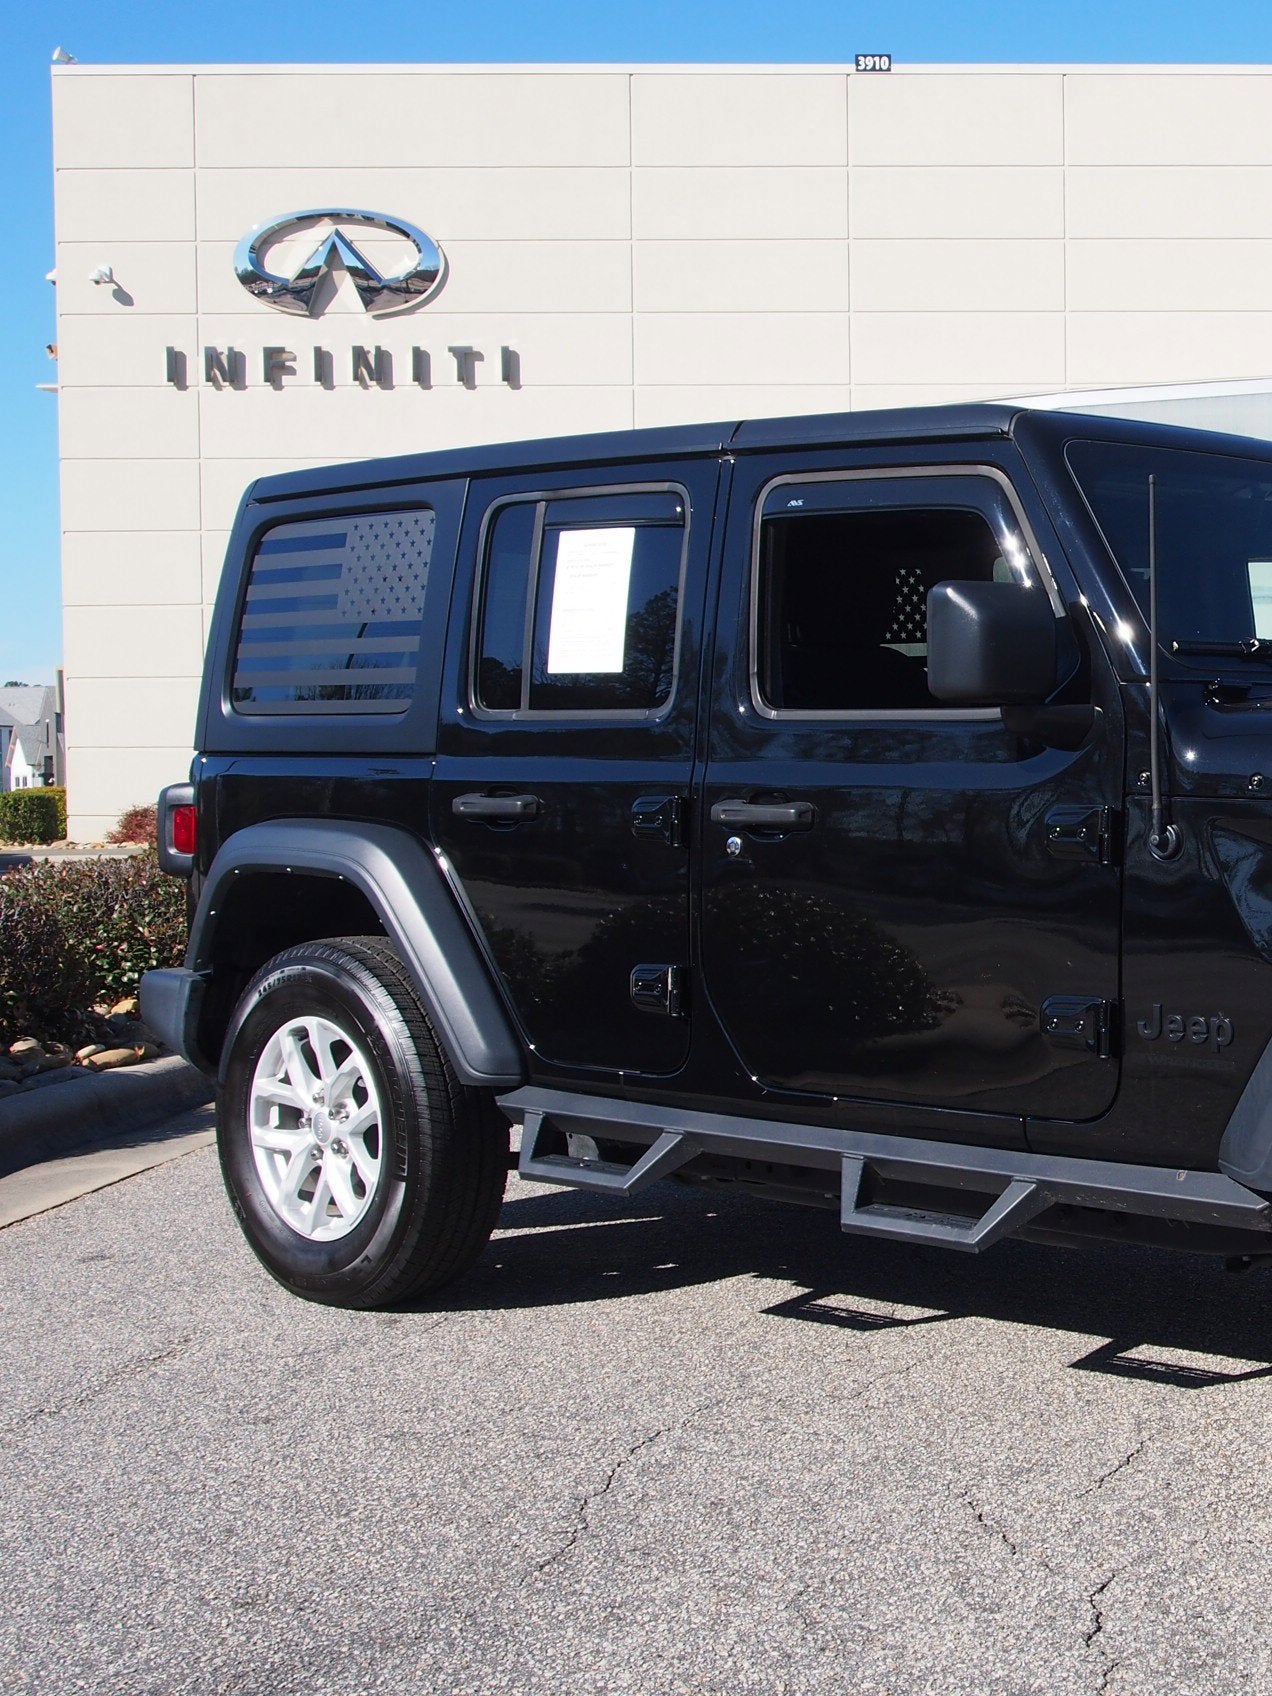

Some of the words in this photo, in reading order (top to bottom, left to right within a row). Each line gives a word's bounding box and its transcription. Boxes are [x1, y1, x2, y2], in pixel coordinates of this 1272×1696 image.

[857, 55, 889, 70] 3910
[165, 345, 521, 388] INFINITI
[1137, 1003, 1235, 1053] Jeep
